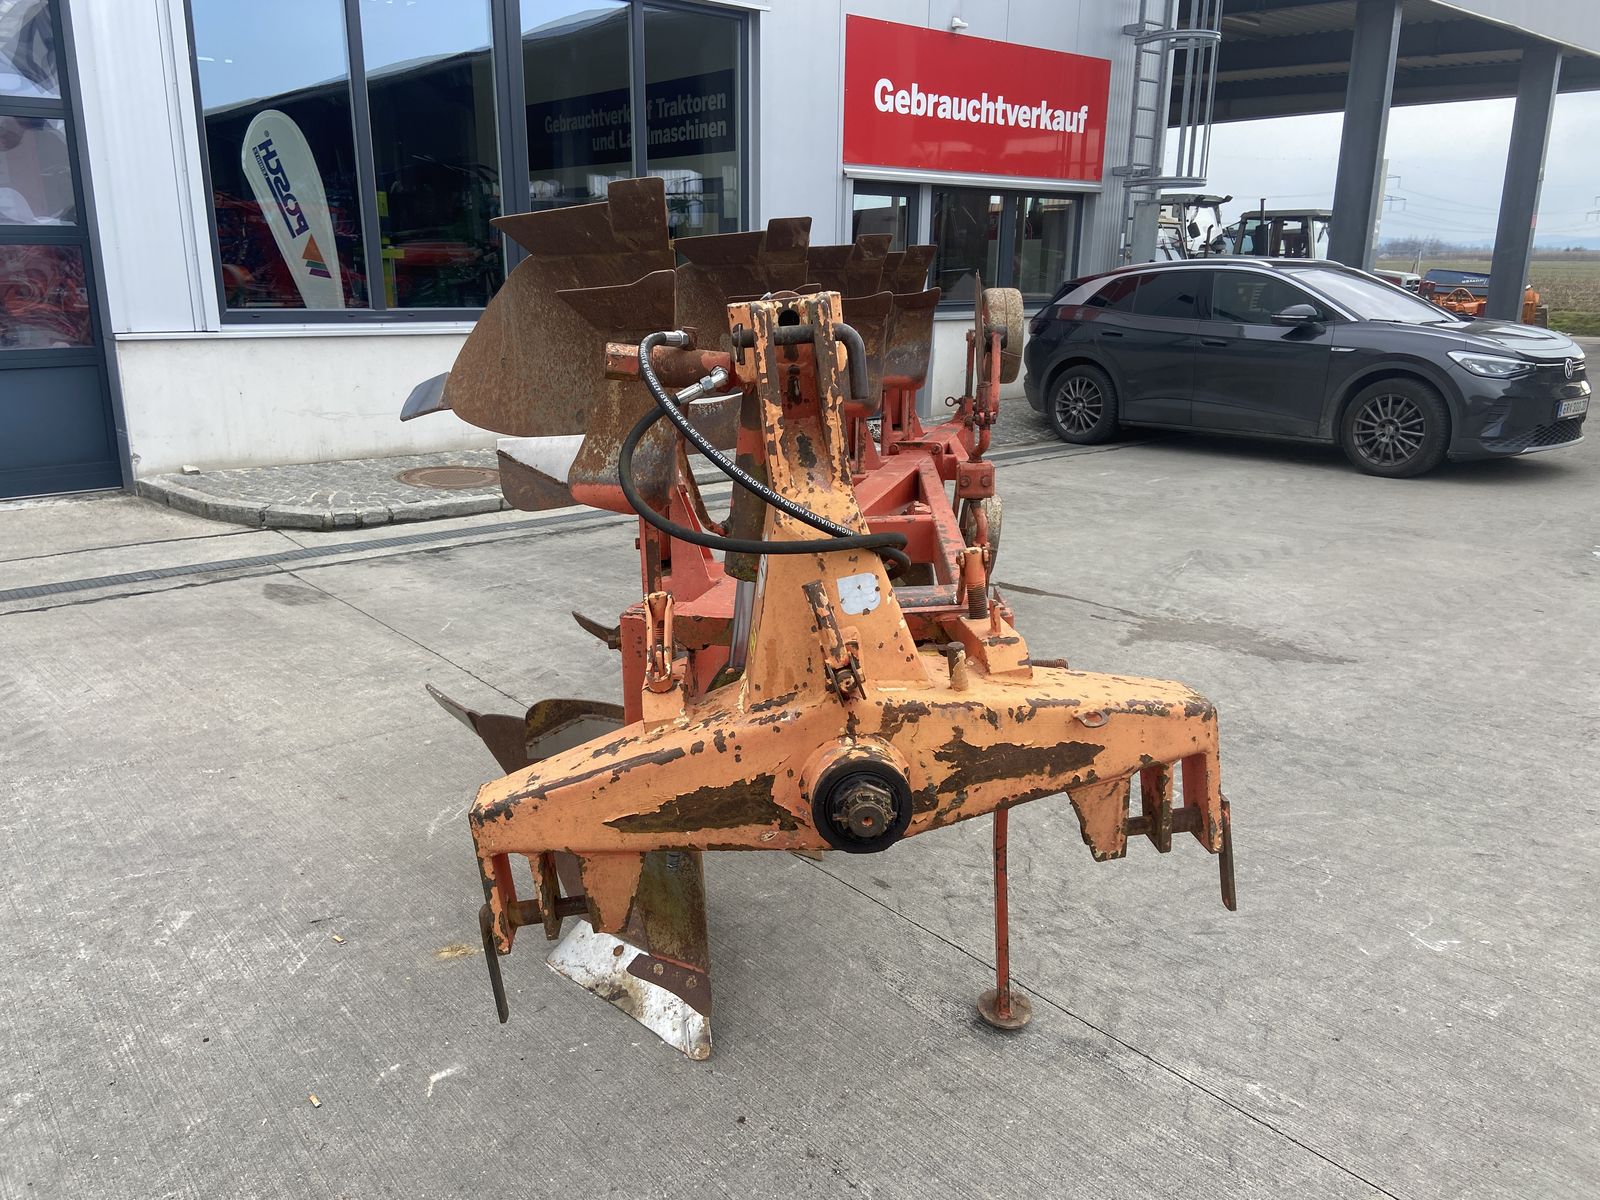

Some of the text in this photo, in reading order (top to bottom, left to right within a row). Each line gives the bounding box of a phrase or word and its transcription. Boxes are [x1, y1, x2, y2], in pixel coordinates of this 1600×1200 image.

[545, 92, 727, 134] Gebrauchtverkf Traktoren
[874, 78, 1088, 134] Gebrauchtverkauf
[592, 119, 727, 151] und Lamaschinen
[697, 436, 712, 450] 2SC
[709, 447, 732, 467] EN857
[729, 463, 744, 476] DIN
[742, 472, 764, 490] HOSE
[762, 485, 805, 515] HYDRAULIC
[804, 510, 836, 530] QUALITY
[835, 525, 853, 536] HIGH
